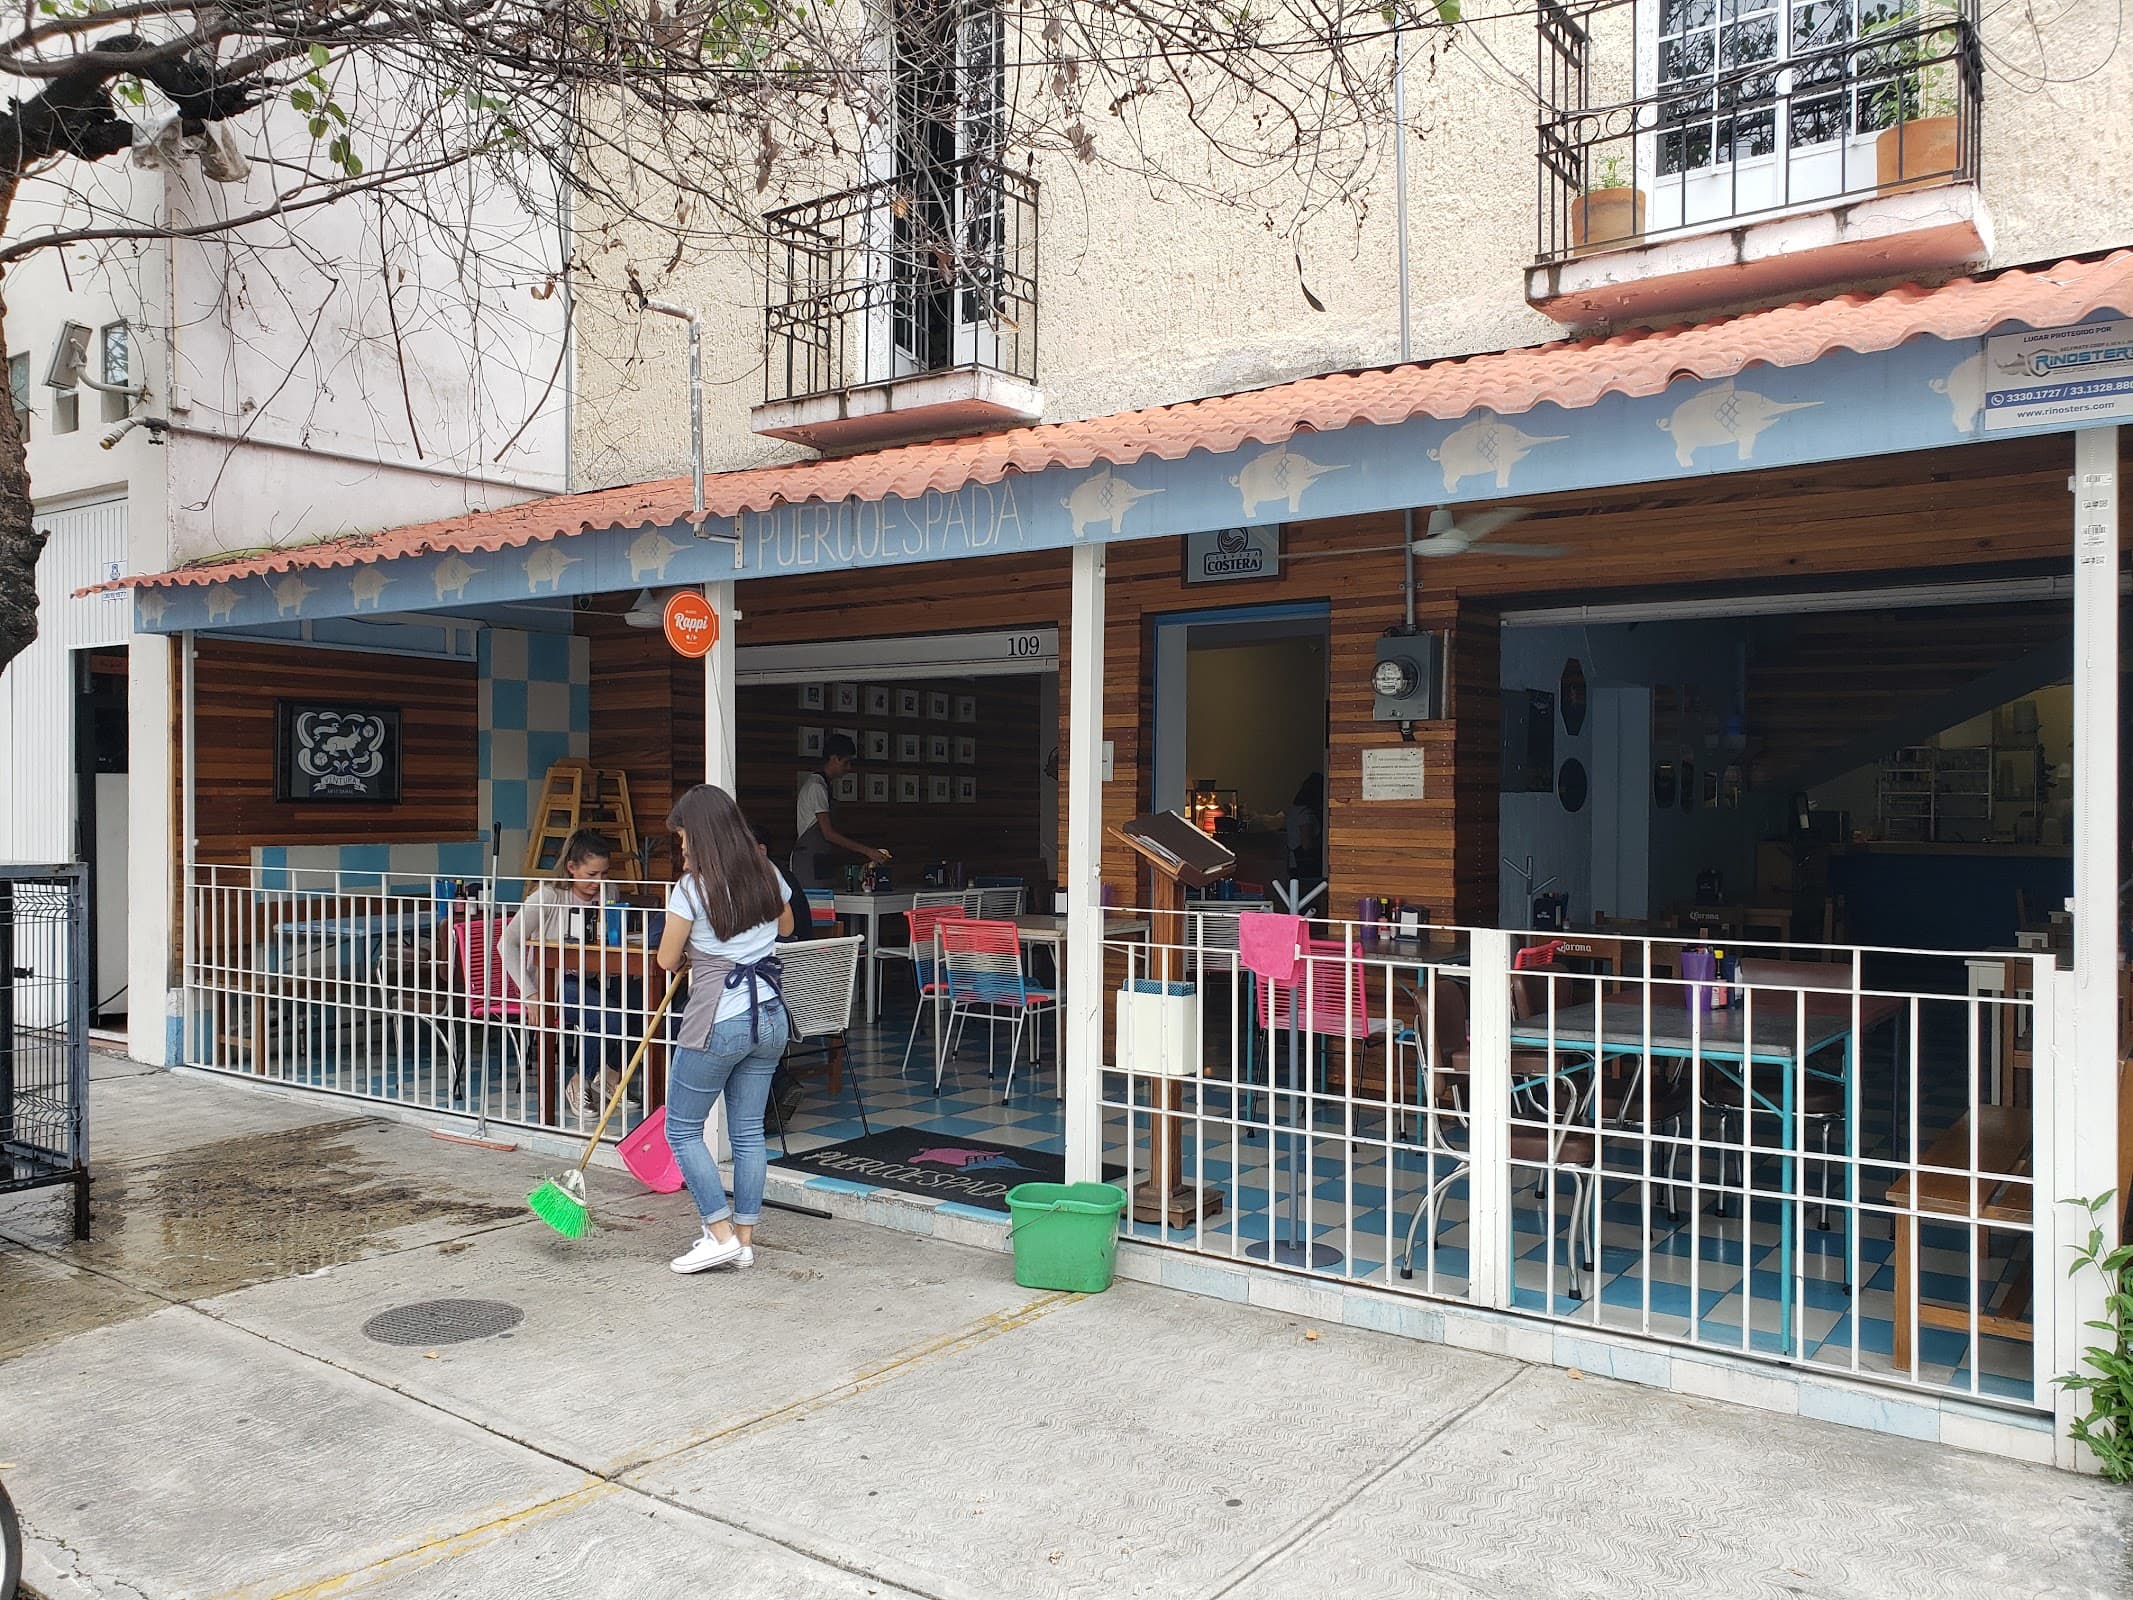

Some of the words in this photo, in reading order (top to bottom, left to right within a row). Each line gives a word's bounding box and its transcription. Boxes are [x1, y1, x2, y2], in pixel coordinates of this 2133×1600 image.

[2023, 333, 2049, 342] LUGAR
[2050, 328, 2094, 340] PROTEGIDO
[2006, 389, 2061, 403] 3330.1727
[2017, 402, 2115, 418] www.rinosters.com
[757, 479, 1024, 570] PUERCOESPADA
[1207, 558, 1258, 572] COSTERA
[674, 612, 709, 633] Rappi
[1007, 635, 1040, 657] 109
[323, 775, 357, 785] VENTURA
